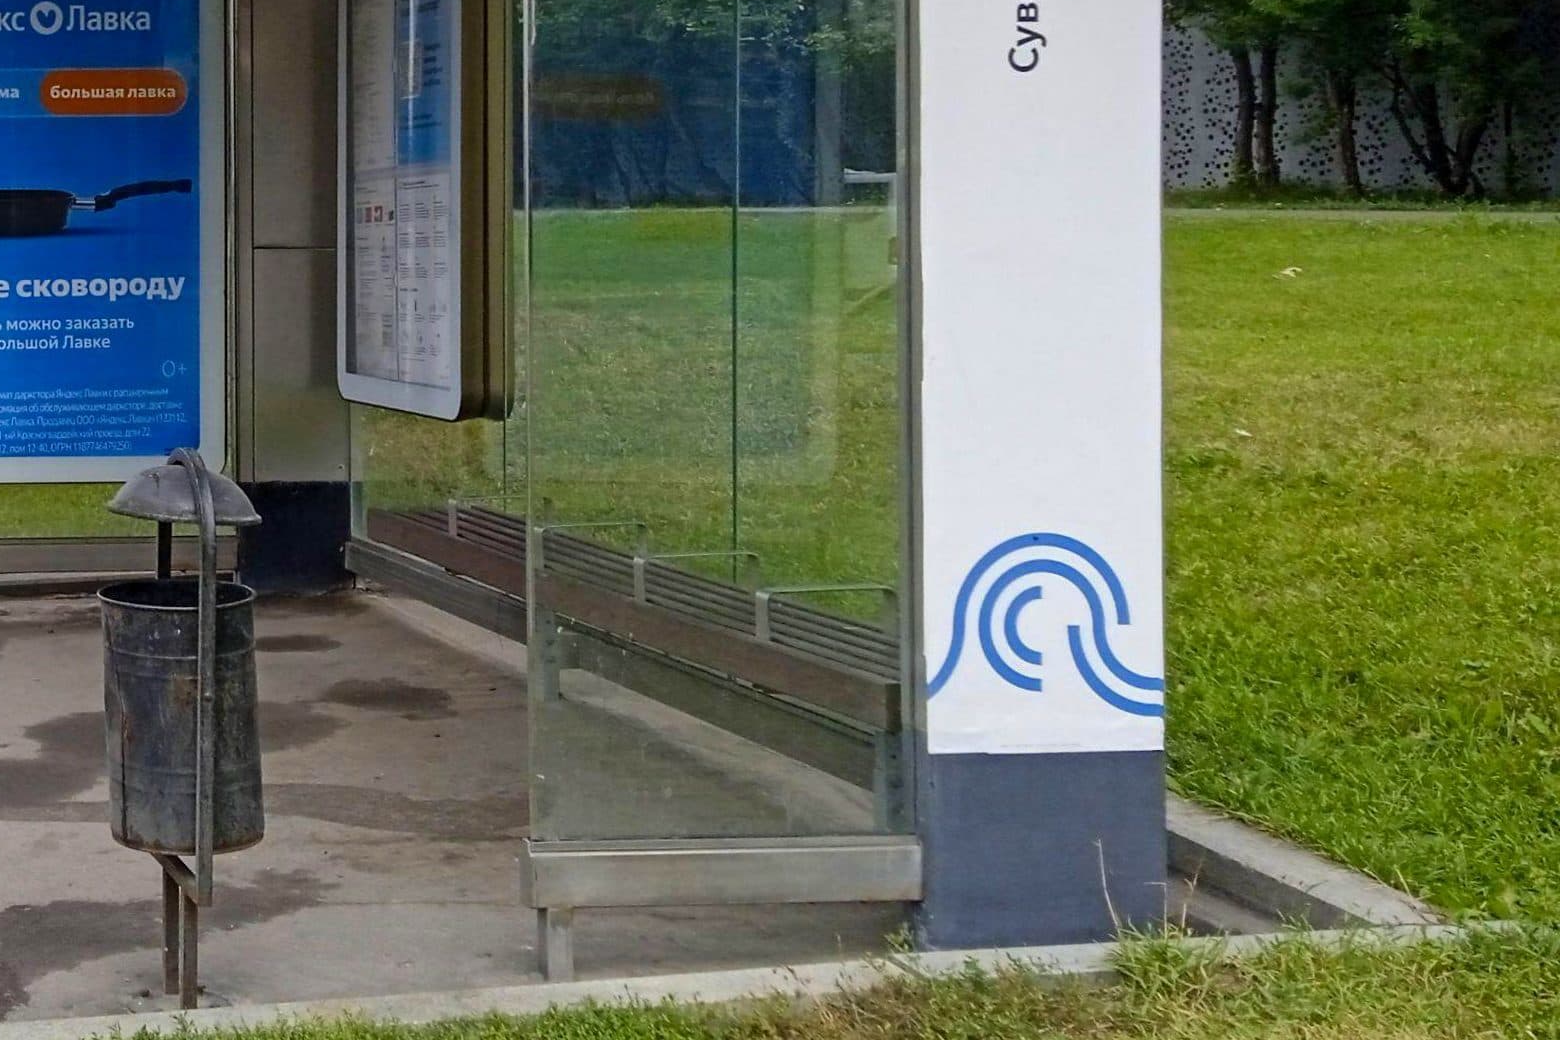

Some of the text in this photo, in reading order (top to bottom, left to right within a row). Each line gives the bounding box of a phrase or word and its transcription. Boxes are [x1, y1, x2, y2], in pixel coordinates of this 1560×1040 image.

[66, 5, 151, 33] Лавка
[50, 84, 176, 100] большая лавка
[15, 276, 186, 302] сковороду
[6, 319, 62, 331] можно
[65, 317, 135, 330] заказать
[62, 335, 111, 350] Лавке
[161, 360, 187, 378] 0+
